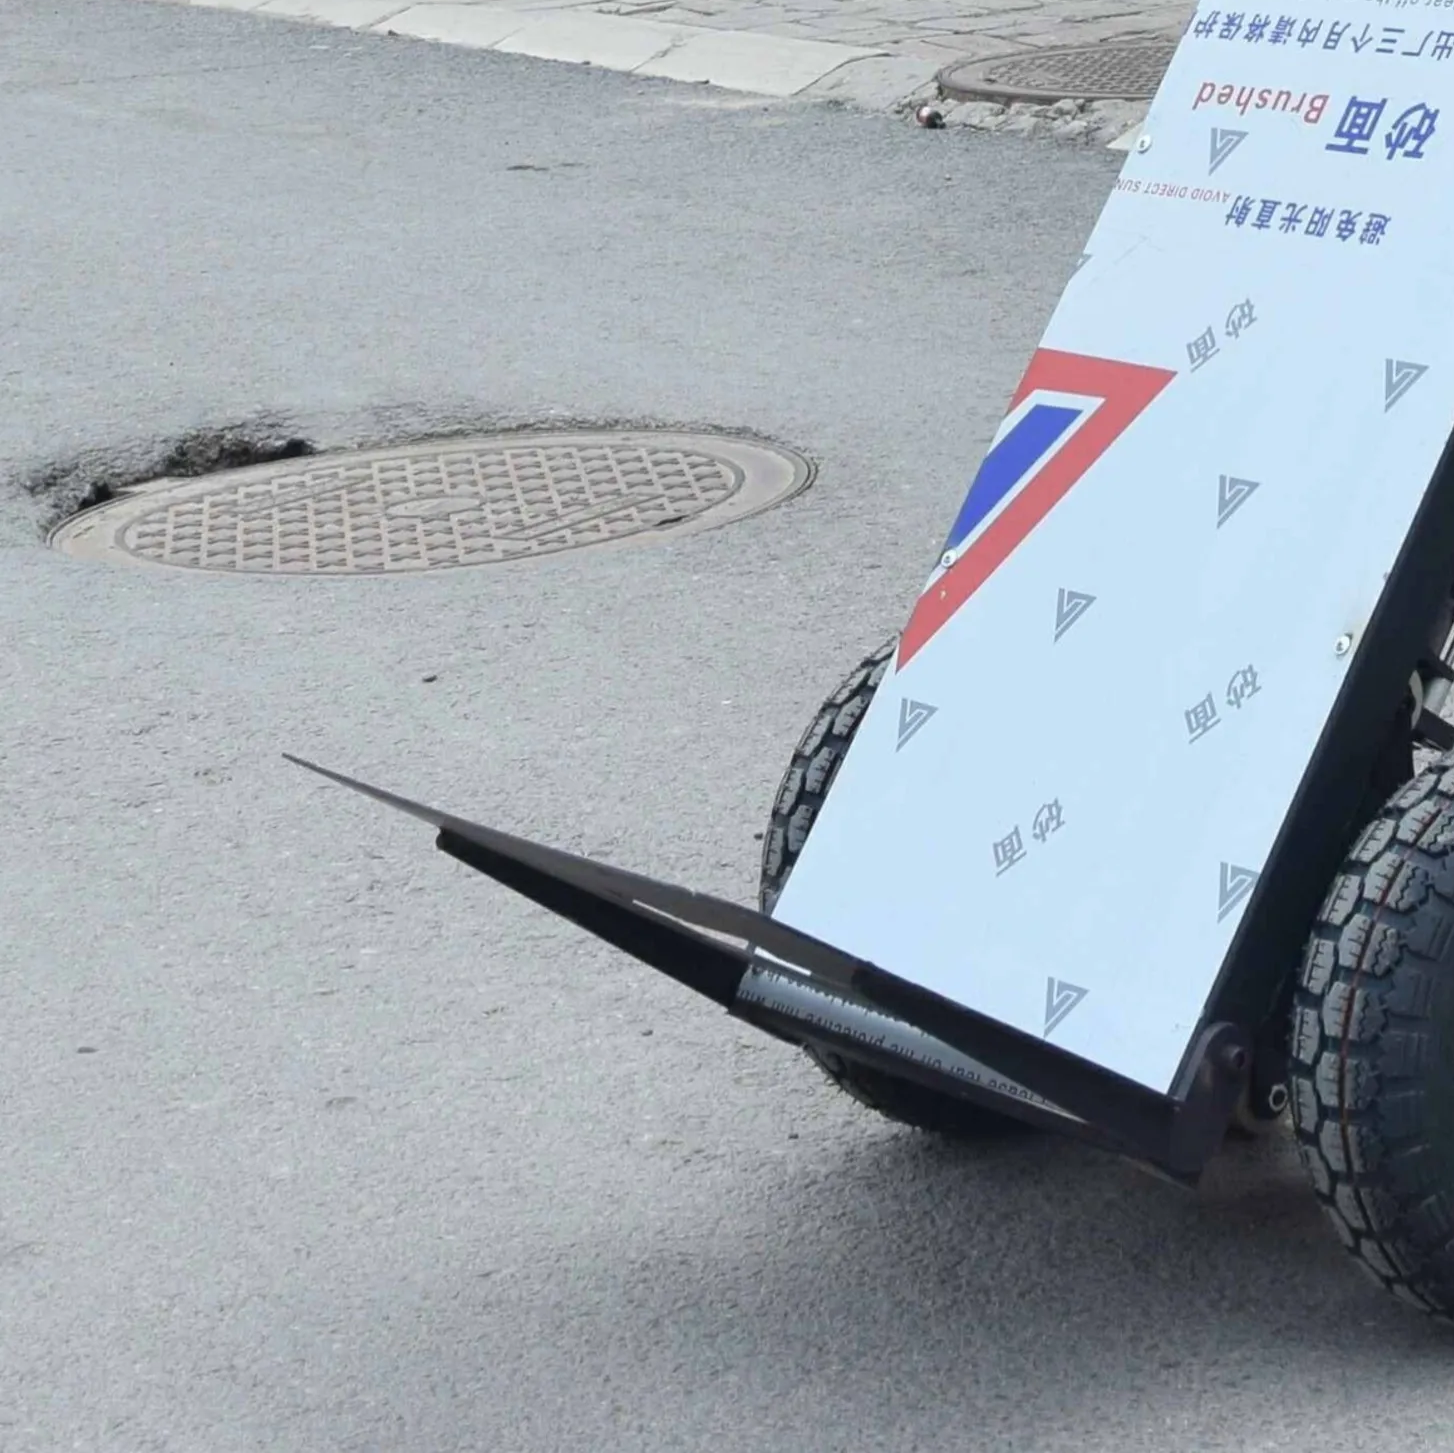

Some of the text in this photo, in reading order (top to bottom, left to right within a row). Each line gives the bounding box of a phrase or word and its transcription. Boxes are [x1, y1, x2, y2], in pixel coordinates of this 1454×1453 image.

[1192, 82, 1330, 125] Brushed
[1325, 95, 1441, 162] 砂面
[1144, 181, 1188, 199] DIRECT
[1191, 187, 1231, 203] AVOID
[1225, 194, 1393, 246] 避免阳光直射
